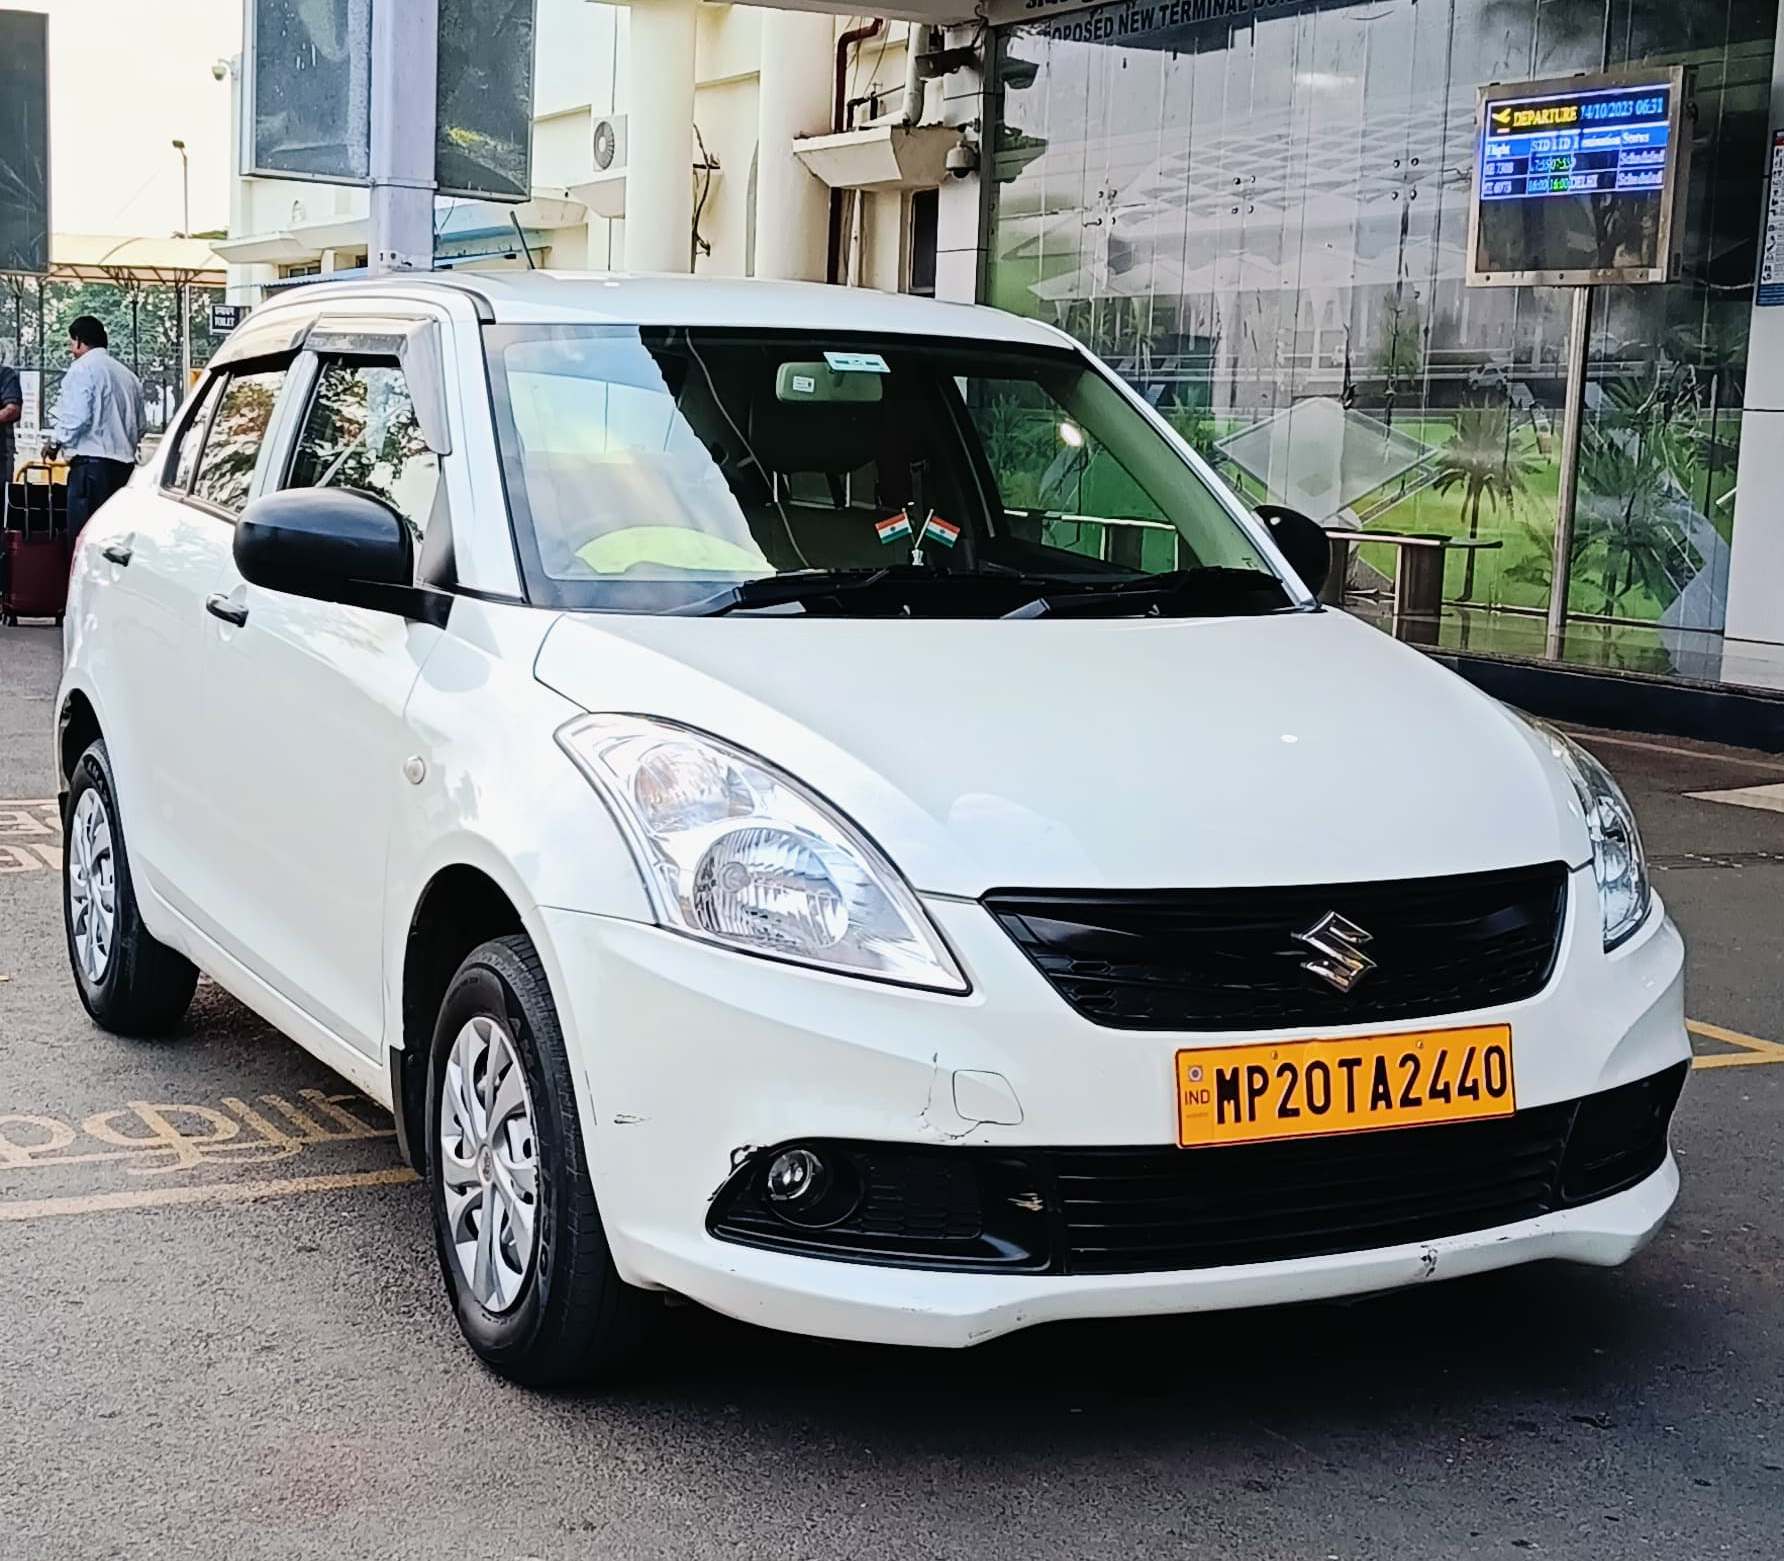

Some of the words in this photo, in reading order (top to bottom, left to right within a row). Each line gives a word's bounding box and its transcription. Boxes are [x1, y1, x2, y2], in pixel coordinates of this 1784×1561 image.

[1118, 10, 1157, 35] NEW
[1159, 0, 1248, 27] TERMINAL
[1513, 106, 1578, 126] DEPARTURE
[1184, 1089, 1210, 1106] IND
[1215, 1045, 1507, 1125] MP20TA2440
